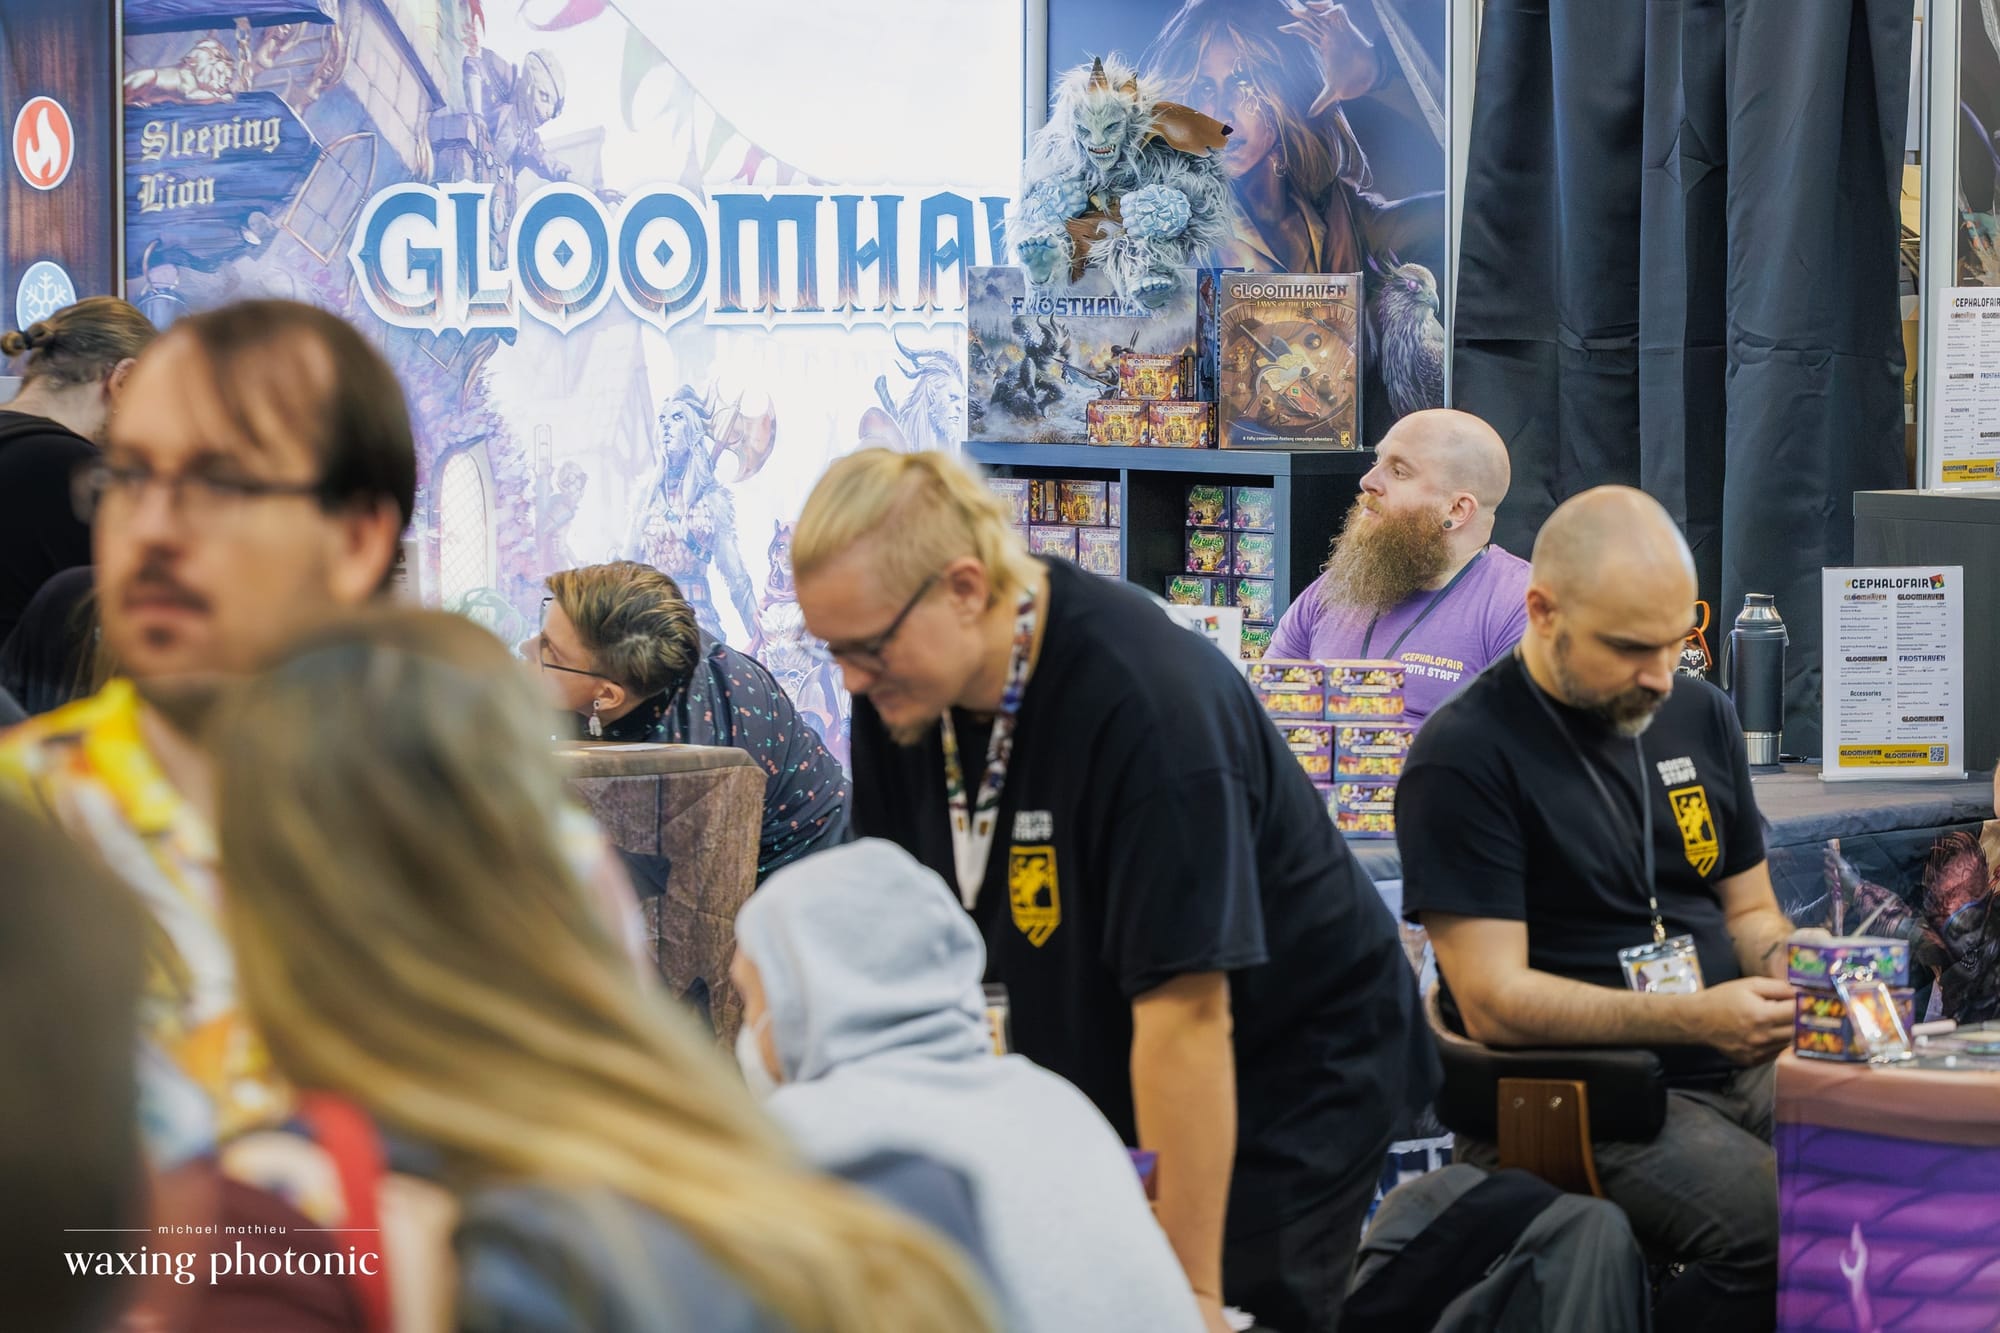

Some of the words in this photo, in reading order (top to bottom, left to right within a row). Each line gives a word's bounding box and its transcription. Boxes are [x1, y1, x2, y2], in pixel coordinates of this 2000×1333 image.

[141, 116, 281, 161] Sleeping
[137, 172, 215, 213] Lion
[1230, 283, 1348, 299] GLOOMHAVEN
[1851, 578, 1929, 589] CEPHALOFAIR
[1897, 593, 1945, 601] GLOOMHAVEN
[1899, 654, 1946, 662] FROSTHAVEN
[1427, 666, 1461, 682] STAFF
